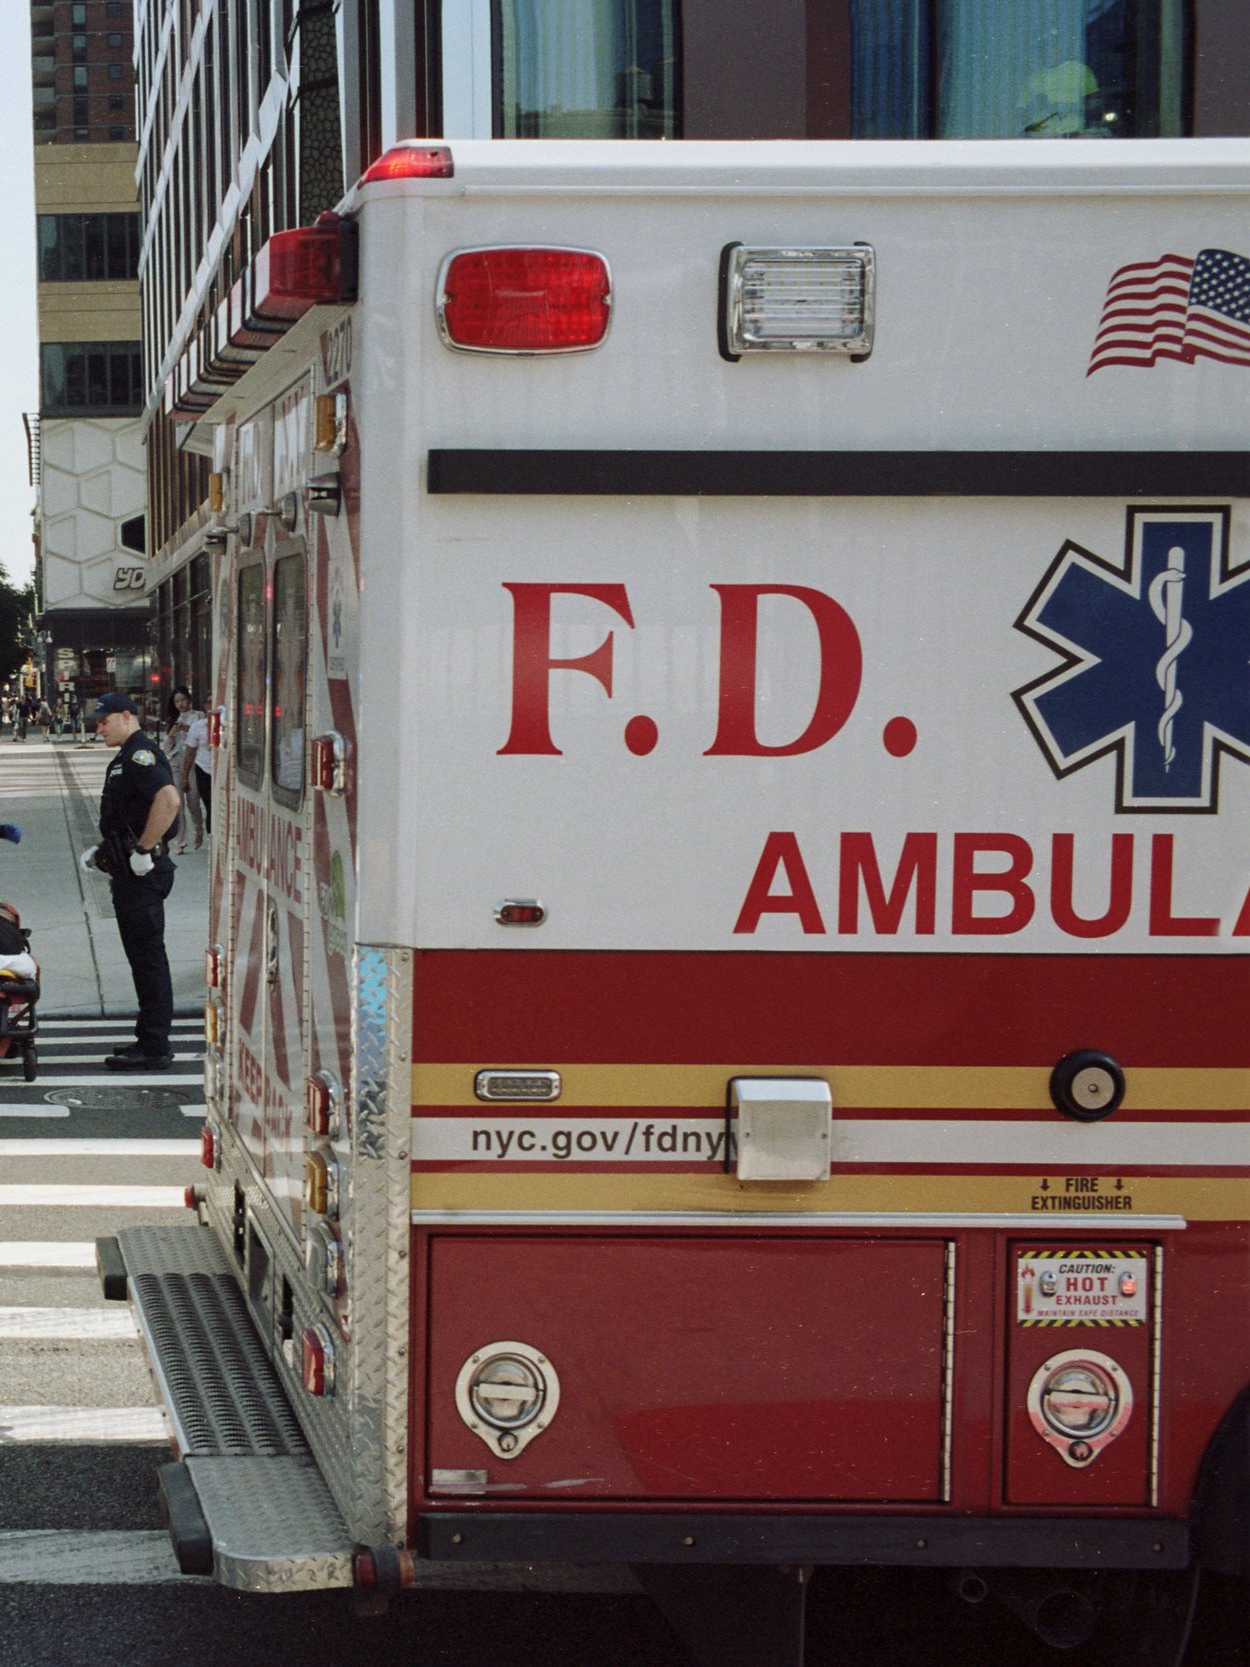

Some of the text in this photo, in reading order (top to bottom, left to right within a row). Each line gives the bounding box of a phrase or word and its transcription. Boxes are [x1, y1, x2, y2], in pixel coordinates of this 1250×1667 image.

[496, 581, 918, 758] F.D.
[733, 831, 1250, 938] AMBUL
[472, 1121, 726, 1161] nyc.gov/fdny
[1065, 1177, 1099, 1193] FIRE
[1031, 1195, 1133, 1211] EXTINGUISHER
[1058, 1263, 1117, 1275] CAUTION:
[1065, 1276, 1109, 1293] HOT
[1055, 1294, 1118, 1306] EXHAUST
[1036, 1308, 1140, 1318] MAINTAIN SAFE DISTANCE
